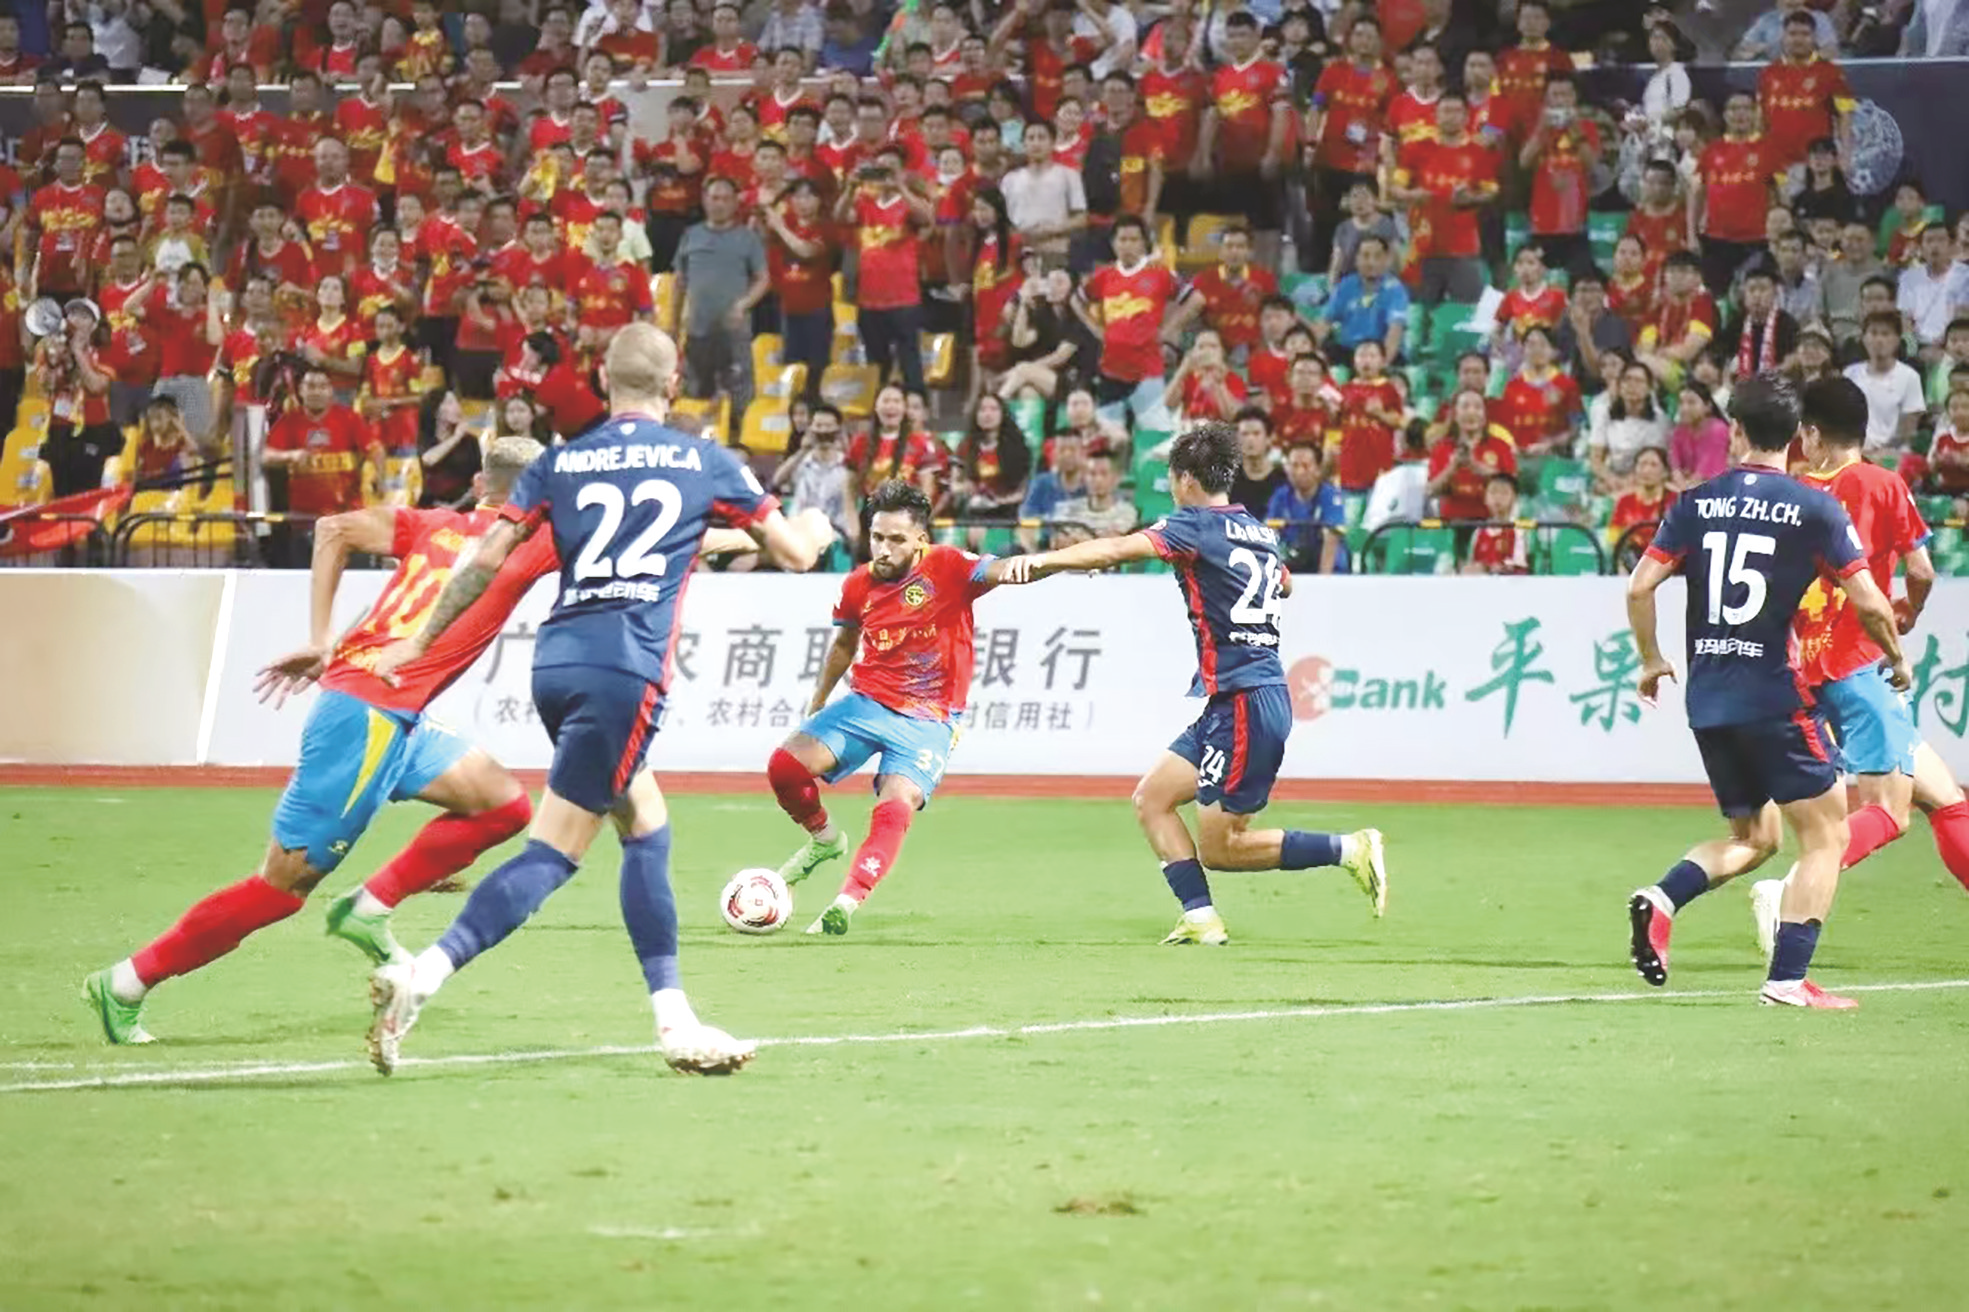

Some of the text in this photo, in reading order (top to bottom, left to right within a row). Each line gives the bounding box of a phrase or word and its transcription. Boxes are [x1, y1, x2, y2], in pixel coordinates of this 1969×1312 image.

[574, 479, 682, 583] 22
[1694, 496, 1802, 527] TONG ZH.CH.
[1702, 531, 1776, 626] 15
